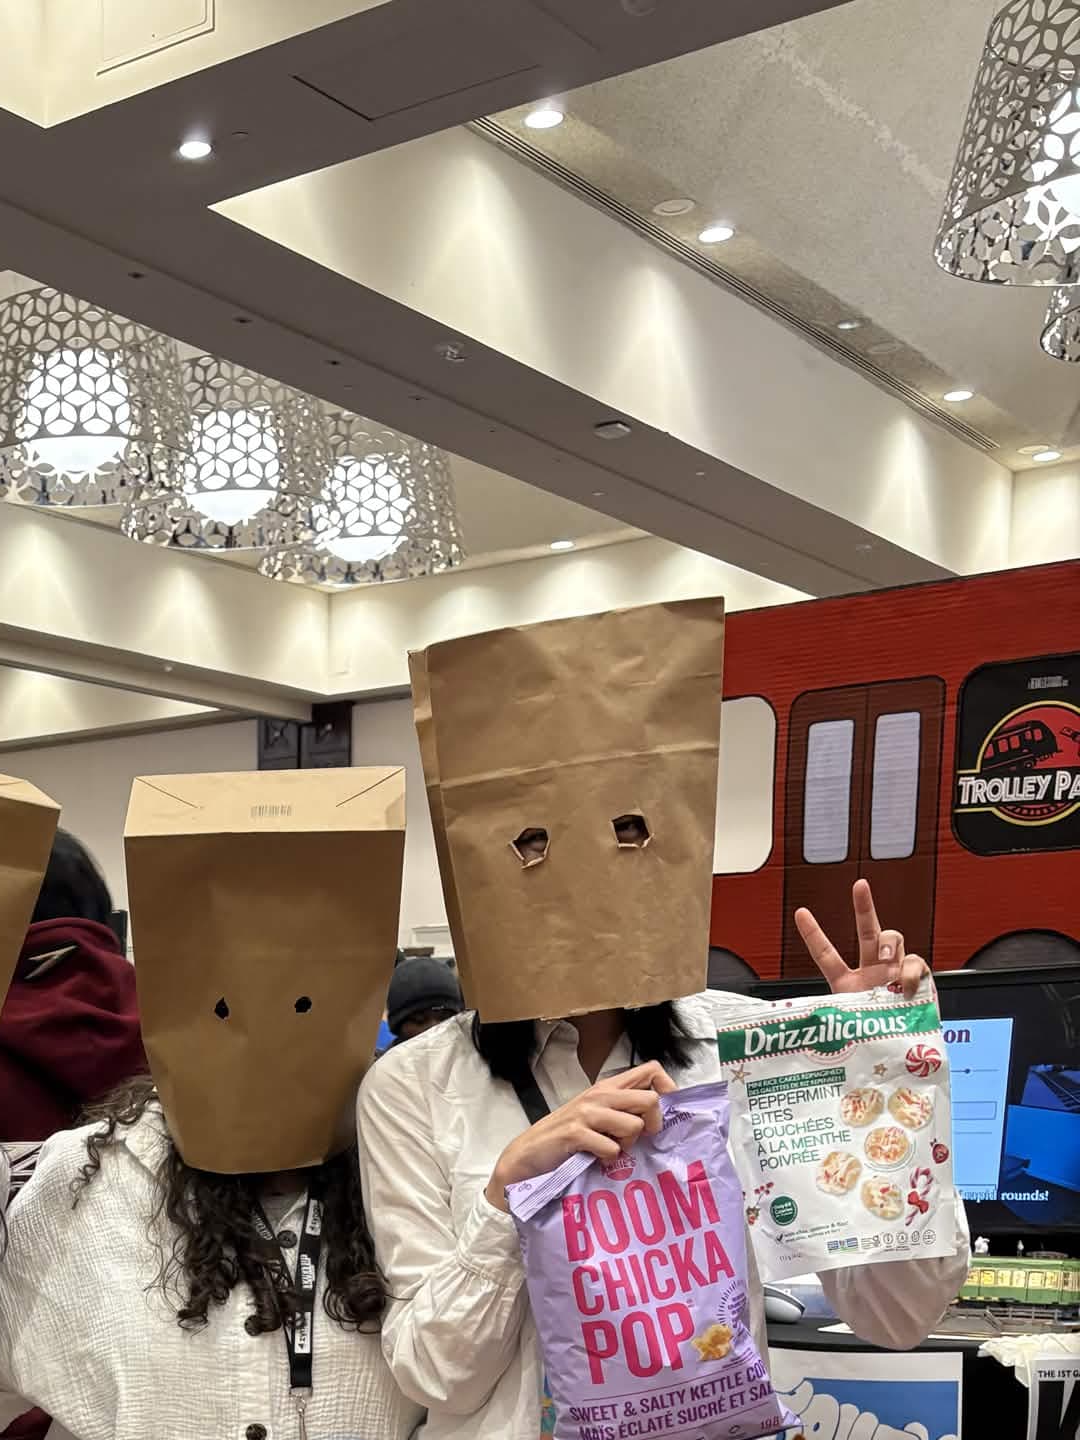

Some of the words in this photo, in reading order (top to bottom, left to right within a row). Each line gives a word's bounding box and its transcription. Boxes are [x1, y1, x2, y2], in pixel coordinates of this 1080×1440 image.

[959, 773, 1052, 804] TROLLEY
[743, 1011, 908, 1056] Drizzilicious
[943, 1028, 971, 1044] on
[748, 1084, 844, 1111] PEPPERMINT
[751, 1109, 794, 1126] BITES
[753, 1117, 834, 1141] BOUCHÉES
[757, 1140, 768, 1156] À
[769, 1138, 789, 1153] LA
[790, 1130, 852, 1150] MENTHE
[759, 1150, 821, 1172] POIVRÉE
[1000, 1189, 1050, 1202] rounds!
[561, 1160, 721, 1262] BOOM
[573, 1230, 736, 1316] CHICKA
[581, 1302, 695, 1385] POP
[1037, 1369, 1056, 1378] THE
[570, 1403, 620, 1423] SWEET
[623, 1401, 638, 1418] &
[640, 1389, 687, 1414] SALTY
[689, 1371, 744, 1400] KETTLE
[618, 1407, 675, 1438] ÉCLATÉ
[677, 1395, 727, 1426] SUCRÉ
[729, 1388, 746, 1409] ET
[749, 1380, 776, 1402] SAL
